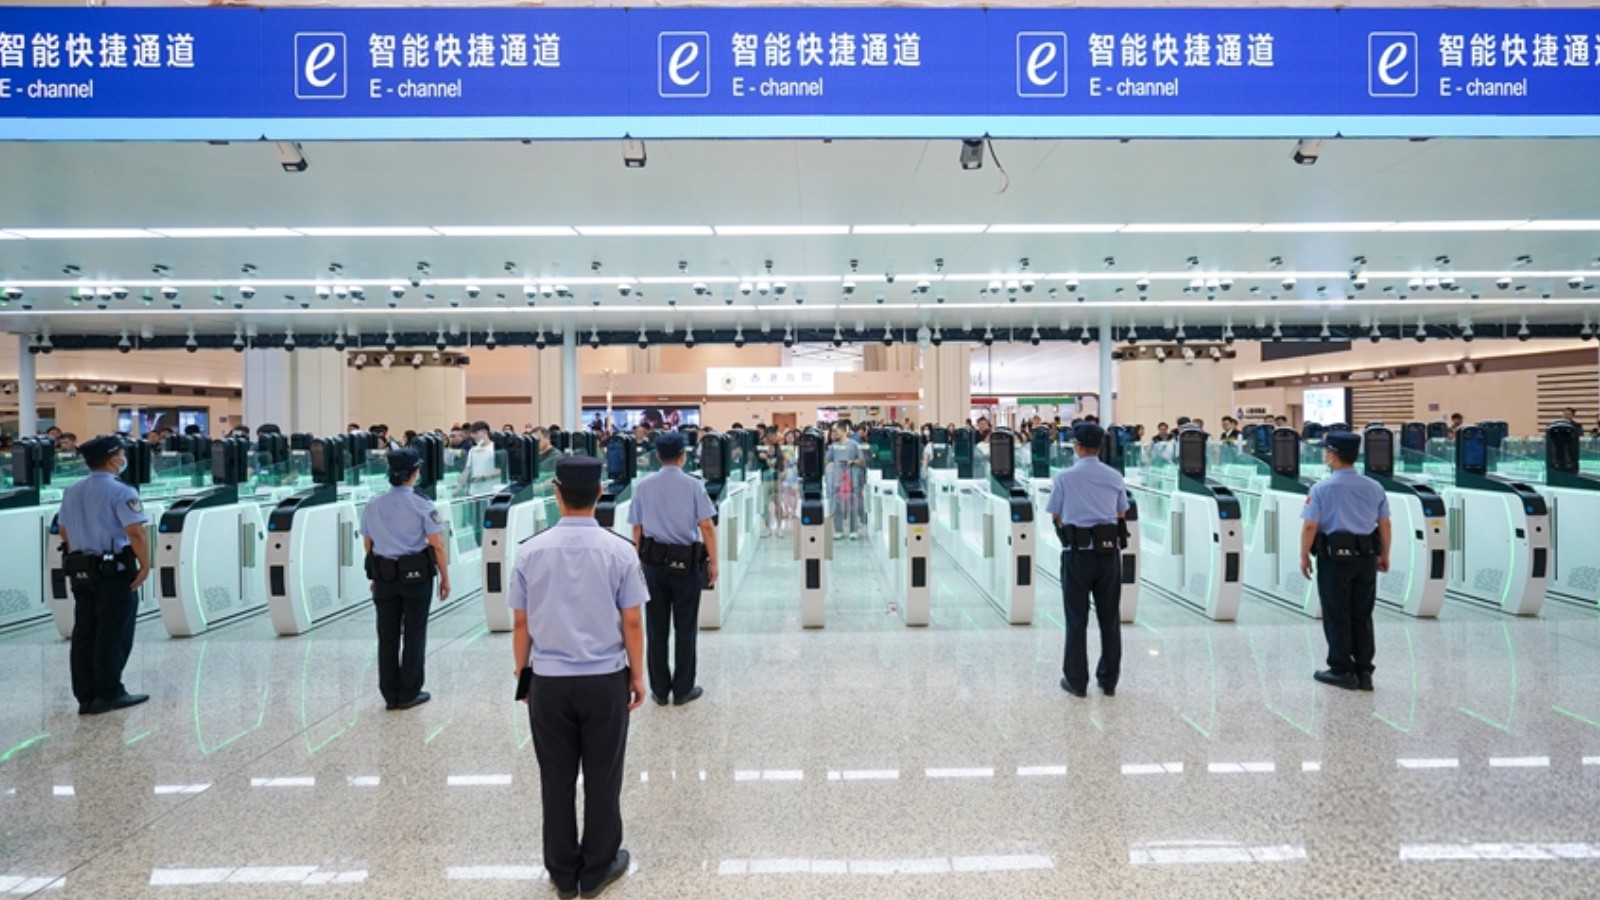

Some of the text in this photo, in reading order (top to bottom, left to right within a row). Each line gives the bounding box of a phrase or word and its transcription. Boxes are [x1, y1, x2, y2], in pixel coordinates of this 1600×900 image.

[0, 32, 195, 68] 智能快捷通道
[305, 42, 337, 88] e
[369, 32, 561, 68] 智能快捷通道
[668, 41, 700, 86] e
[731, 31, 921, 67] 智能快捷通道
[1026, 41, 1058, 86] e
[1088, 32, 1274, 67] 智能快捷通道
[1377, 41, 1409, 86] e
[1439, 33, 1600, 67] 智能快捷通
[28, 79, 94, 98] channel
[397, 79, 462, 98] channel
[759, 77, 823, 97] channel
[1116, 77, 1179, 97] channel
[1466, 77, 1527, 96] channel
